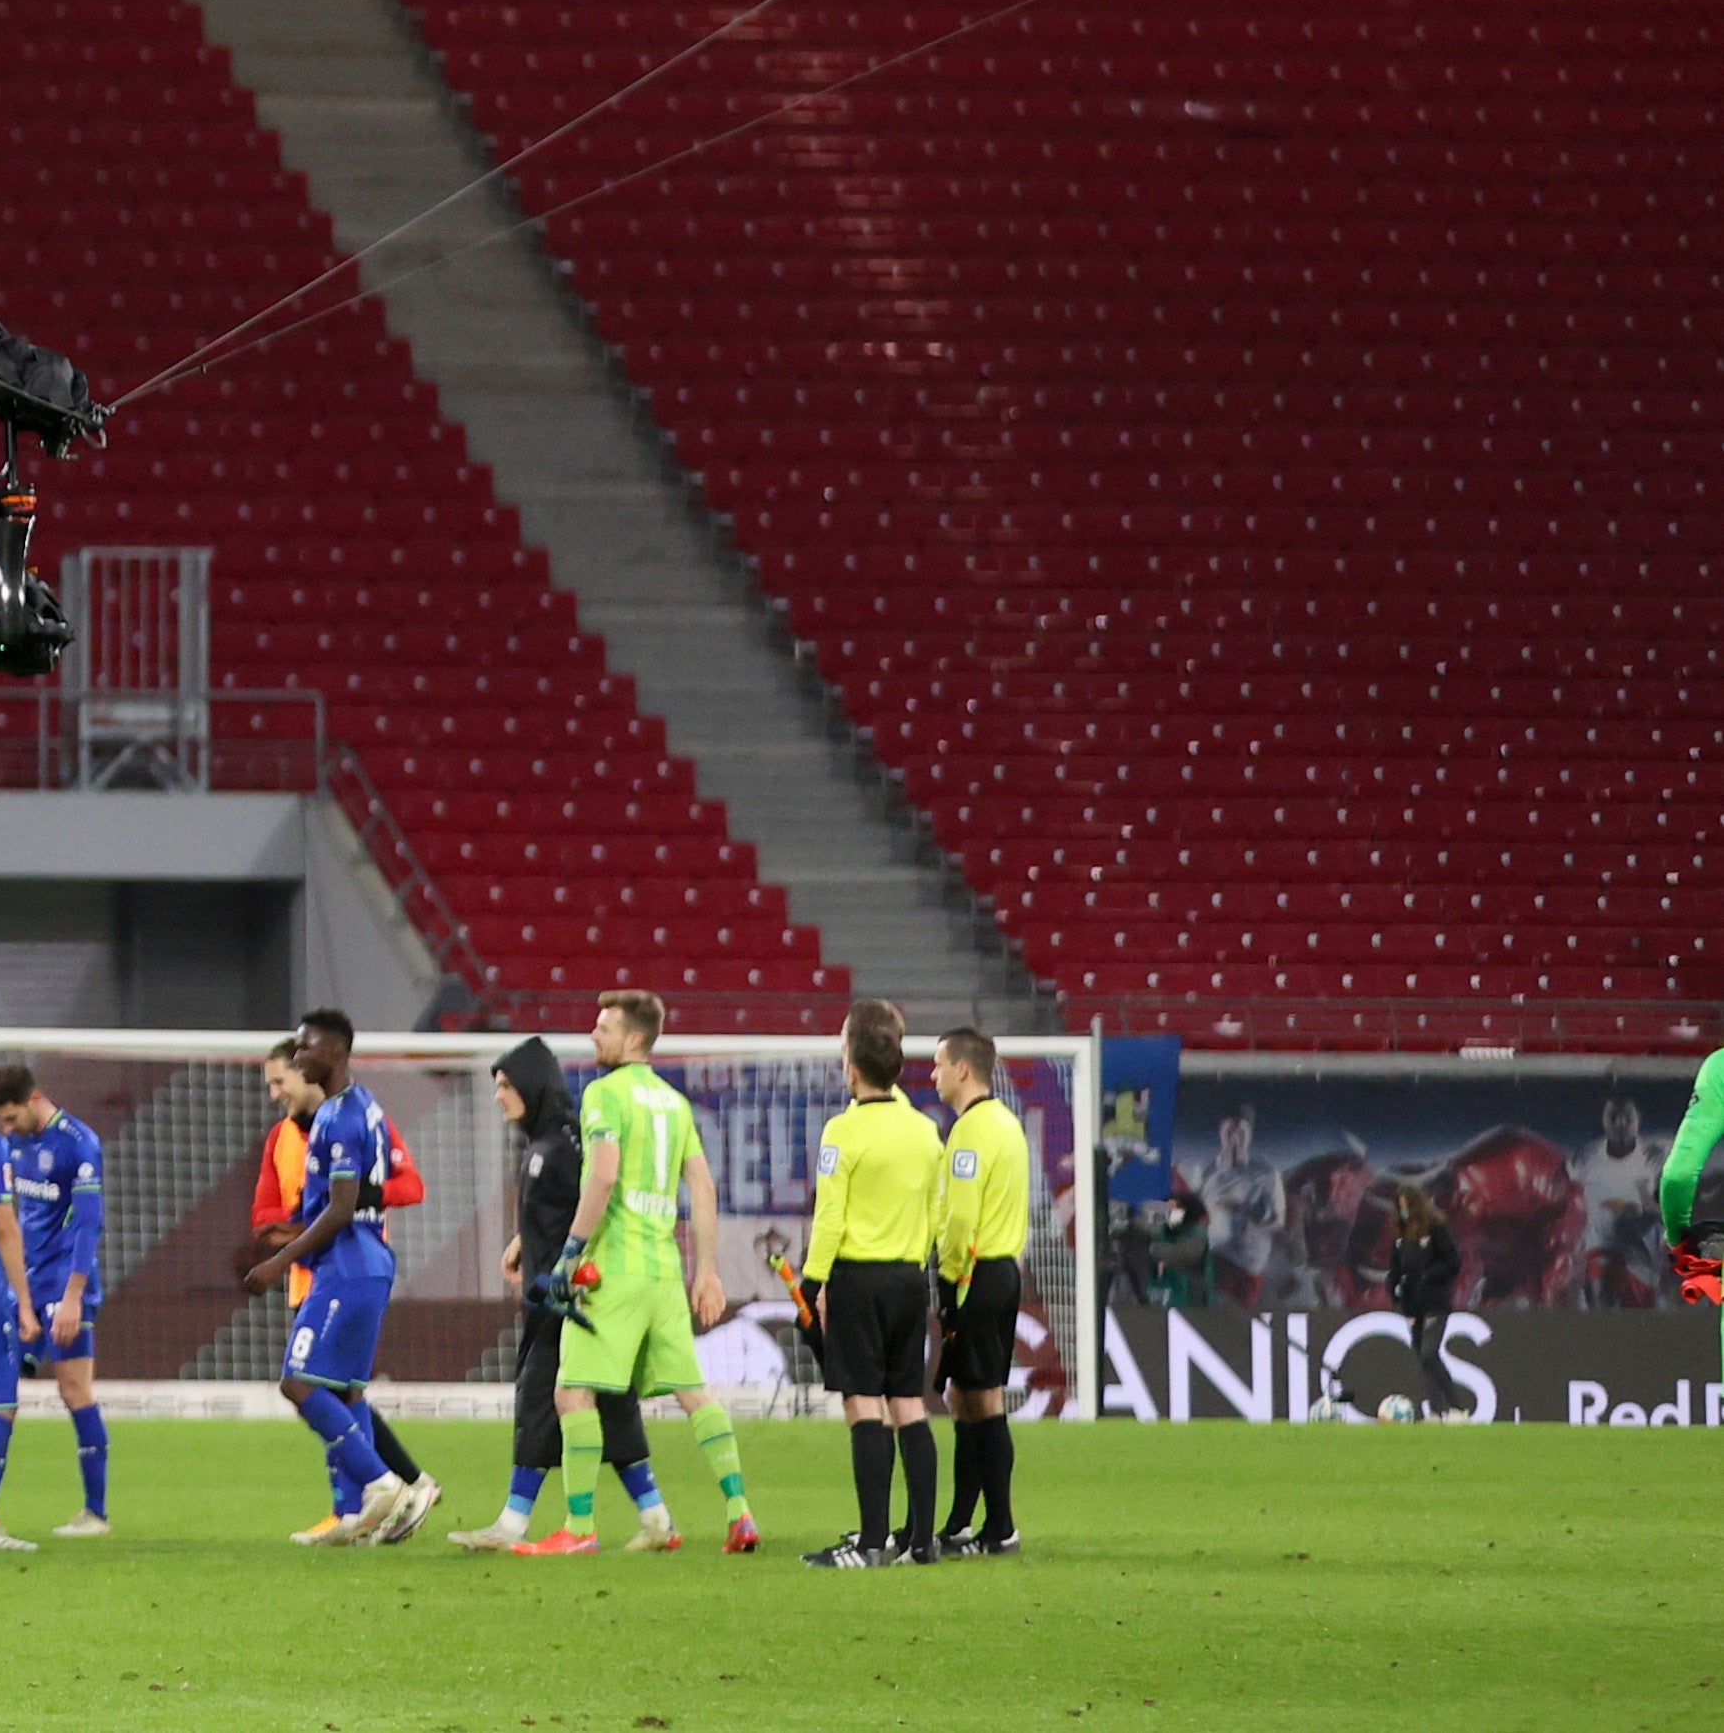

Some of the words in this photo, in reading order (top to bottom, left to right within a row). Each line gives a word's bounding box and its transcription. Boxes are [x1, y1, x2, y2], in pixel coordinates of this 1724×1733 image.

[653, 1112, 669, 1190] 1
[291, 1325, 315, 1360] 6
[1568, 1378, 1691, 1428] Red
